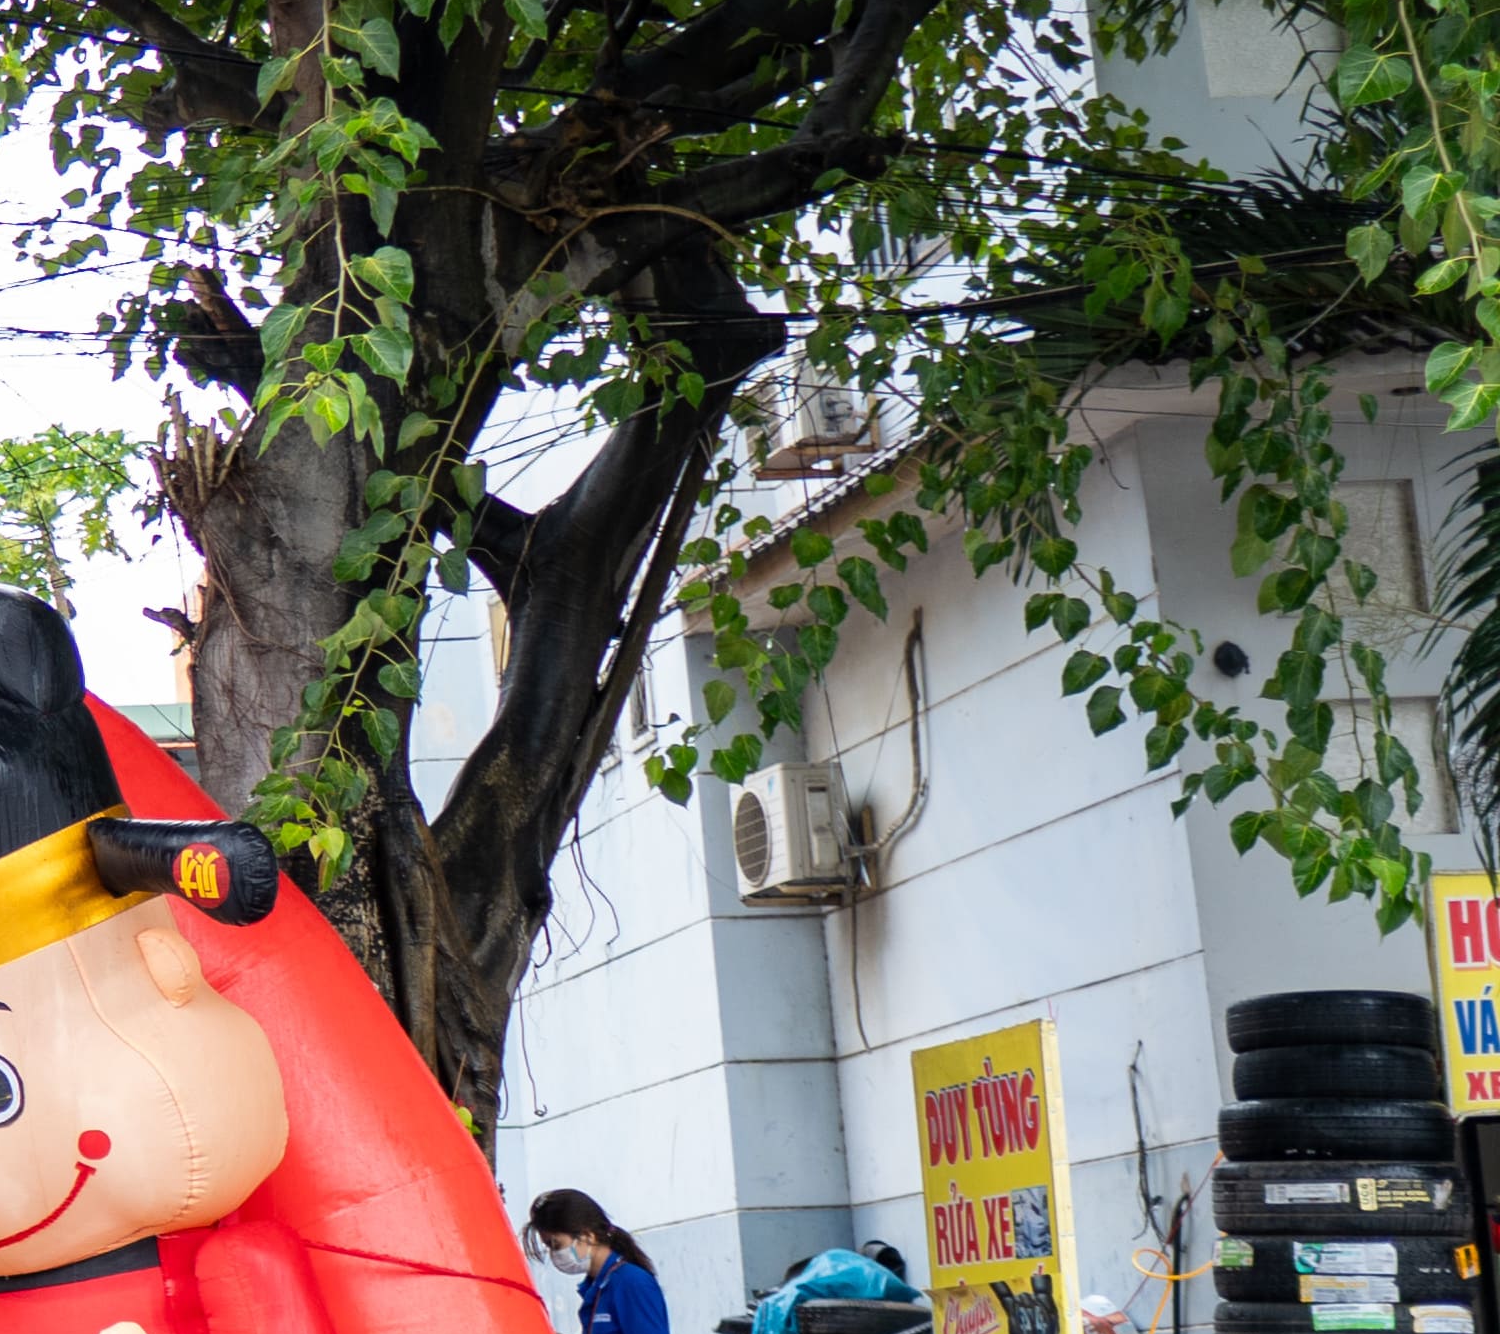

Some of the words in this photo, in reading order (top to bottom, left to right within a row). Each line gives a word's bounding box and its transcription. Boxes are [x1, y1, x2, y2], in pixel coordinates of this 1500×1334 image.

[925, 1082, 972, 1167] DUY
[972, 1056, 1040, 1158] TÙNG
[933, 1182, 981, 1267] RỬA
[982, 1195, 1014, 1261] XE
